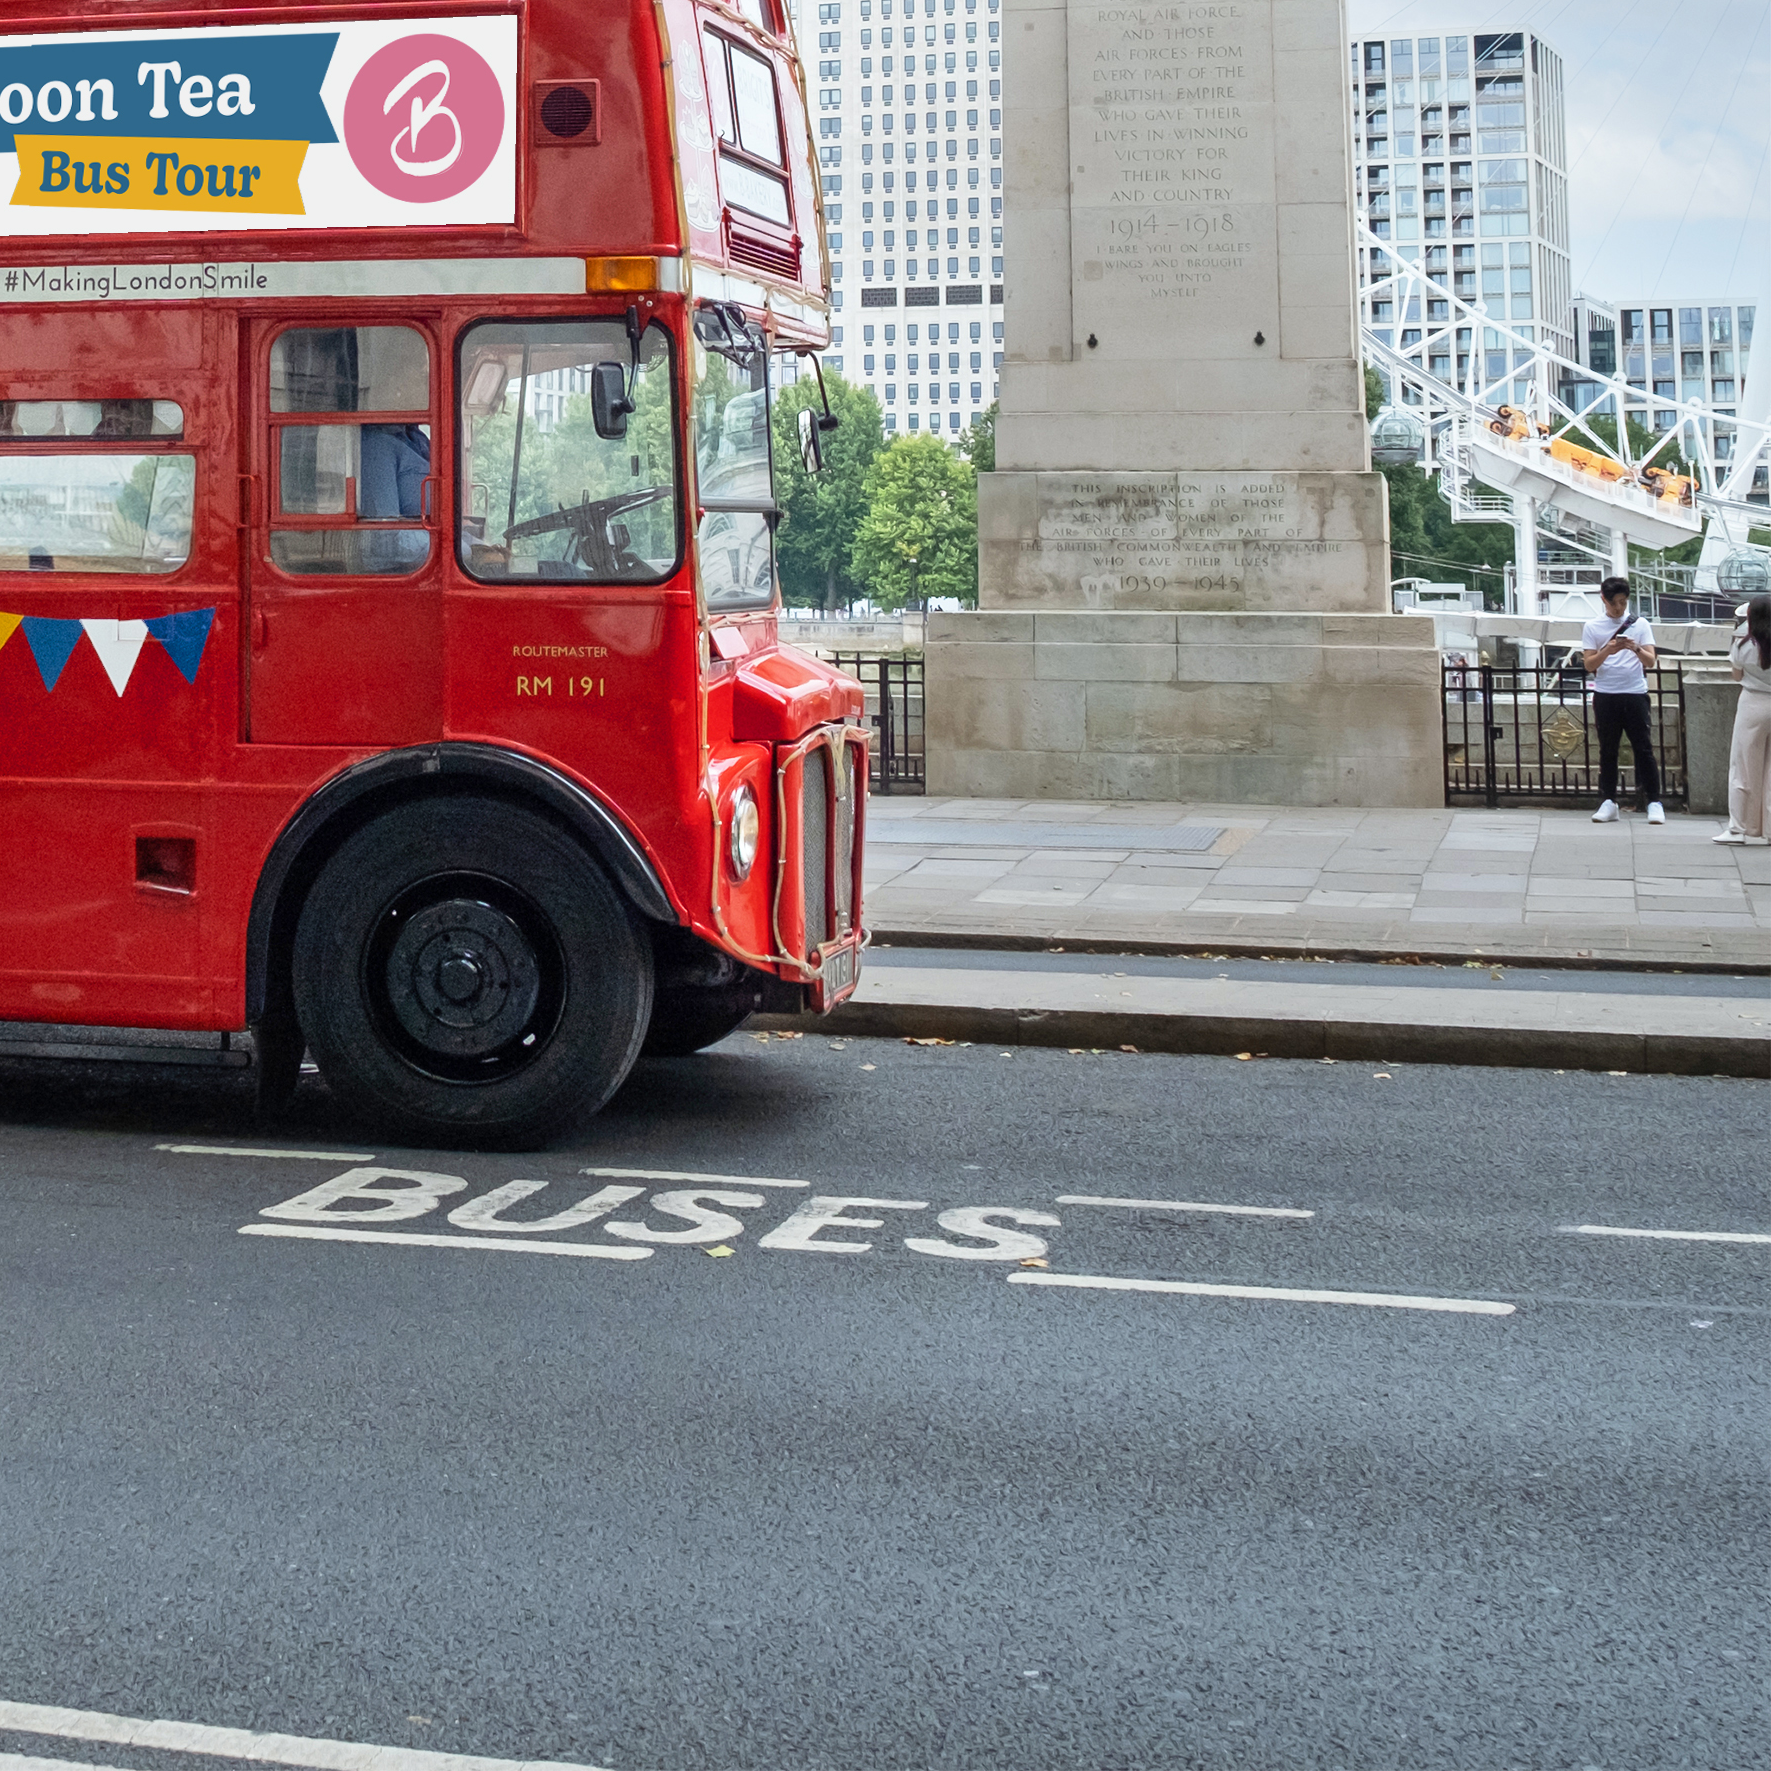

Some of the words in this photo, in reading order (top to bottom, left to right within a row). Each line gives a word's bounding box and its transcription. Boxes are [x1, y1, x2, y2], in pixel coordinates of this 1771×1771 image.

[1099, 9, 1146, 22] ROYAL
[1154, 8, 1179, 20] AIR
[1189, 6, 1241, 19] FORCE
[1122, 29, 1154, 40] AND
[1164, 27, 1214, 39] THOSE
[1095, 50, 1120, 61] AIR
[1129, 48, 1187, 60] FORCES
[1198, 46, 1242, 58] FROM
[1093, 69, 1136, 81] EVERY
[1144, 68, 1182, 80] PART
[1188, 67, 1206, 78] OF
[1215, 66, 1245, 78] THE
[137, 60, 256, 119] Tea
[1105, 89, 1163, 101] BRITISH
[1177, 87, 1235, 99] EMPIRE
[1099, 110, 1136, 121] WHO
[1145, 109, 1184, 120] GAVE
[1193, 107, 1241, 119] THEIR
[1095, 130, 1137, 142] LIVES
[1148, 129, 1164, 141] IN
[1174, 127, 1248, 139] WINNING
[1115, 149, 1186, 161] VICTORY
[1197, 148, 1228, 160] FOR
[39, 149, 130, 195] Bus
[145, 151, 261, 198] Tour
[1121, 170, 1170, 181] THEIR
[1182, 168, 1221, 180] KING
[1110, 190, 1144, 201] AND
[1154, 189, 1233, 201] COUNTRY
[5, 264, 267, 298] #MakingLondonSmile
[1072, 484, 1101, 493] THIS
[1117, 484, 1201, 493] INSCRIPTION
[1216, 485, 1226, 493] IS
[1241, 484, 1285, 493] ADDED
[1211, 499, 1227, 508] OF
[1243, 499, 1285, 508] THOSE
[1165, 514, 1216, 522] WOMEN
[1230, 514, 1246, 522] OF
[1262, 514, 1285, 522] THE
[1052, 528, 1072, 536] AIR
[1086, 528, 1136, 537] FORCES
[1151, 528, 1167, 536] OF
[1183, 529, 1222, 537] EVERY
[1238, 529, 1269, 537] PART
[1286, 529, 1303, 537] OF
[1057, 543, 1102, 551] BRITISH
[1117, 543, 1236, 552] COMMONWEALTH
[1253, 543, 1281, 552] AND
[1093, 557, 1124, 566] WHO
[1139, 557, 1172, 566] GAVE
[1185, 557, 1220, 566] THEIR
[1234, 557, 1269, 567] LIVES
[513, 646, 608, 658] ROUTEMASTER
[517, 676, 552, 696] RM
[569, 676, 604, 697] 191
[258, 1167, 1062, 1260] BUSES
